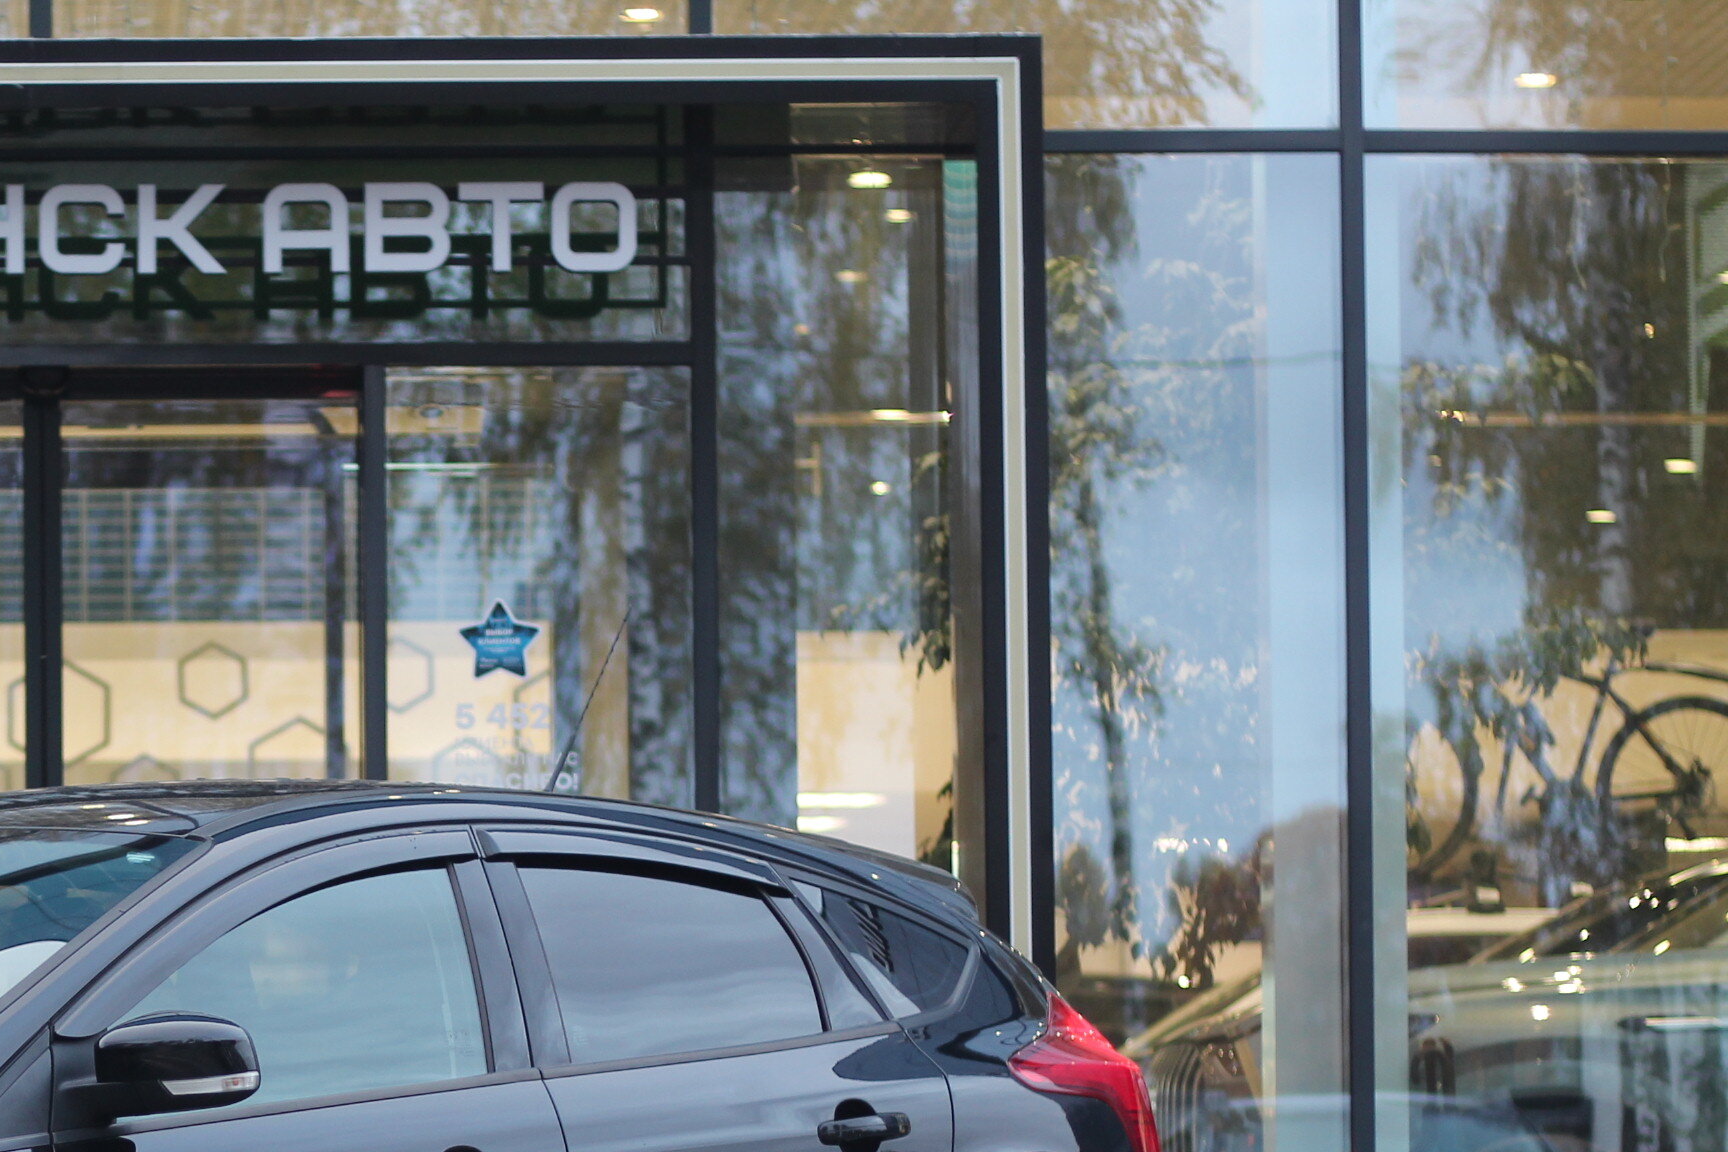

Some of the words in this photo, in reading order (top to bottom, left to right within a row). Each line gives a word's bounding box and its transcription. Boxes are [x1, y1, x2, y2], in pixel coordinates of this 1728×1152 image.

[262, 181, 638, 273] АВТО
[455, 703, 475, 729] 5
[486, 703, 550, 729] 452
